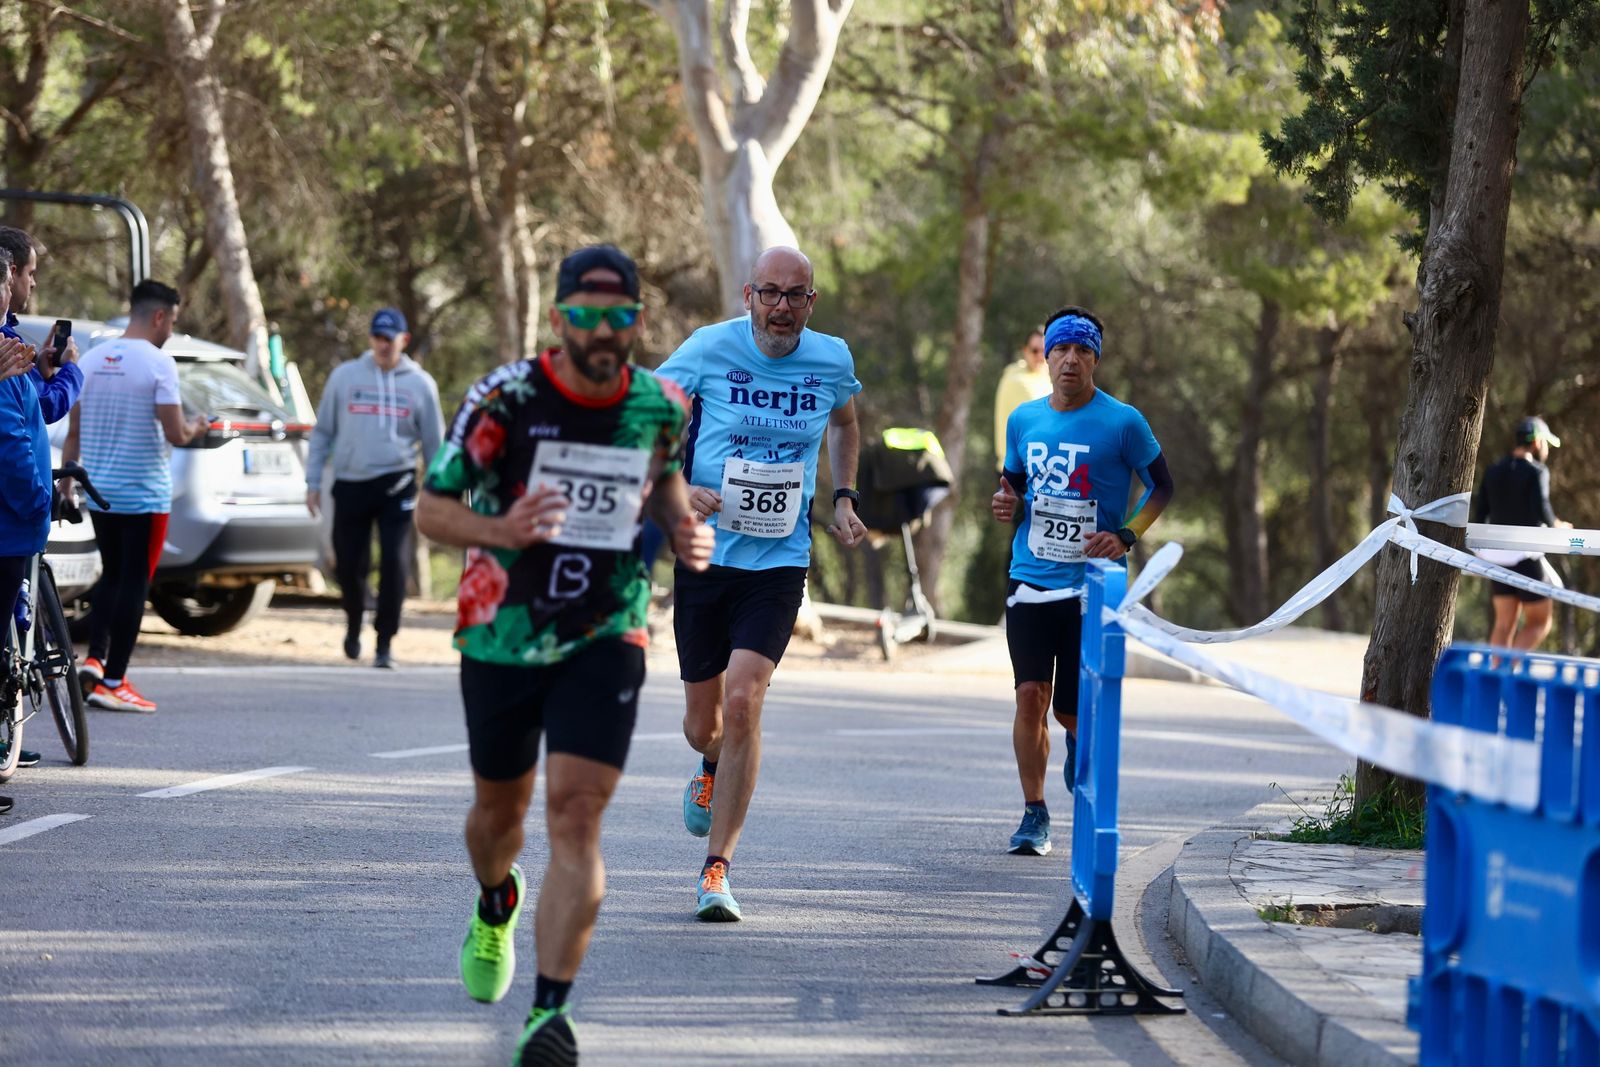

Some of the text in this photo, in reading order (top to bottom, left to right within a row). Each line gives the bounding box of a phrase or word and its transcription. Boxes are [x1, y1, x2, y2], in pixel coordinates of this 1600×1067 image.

[728, 385, 817, 417] nerja
[740, 415, 807, 431] ATLETISMO
[739, 489, 787, 514] 368
[1044, 519, 1081, 542] 292
